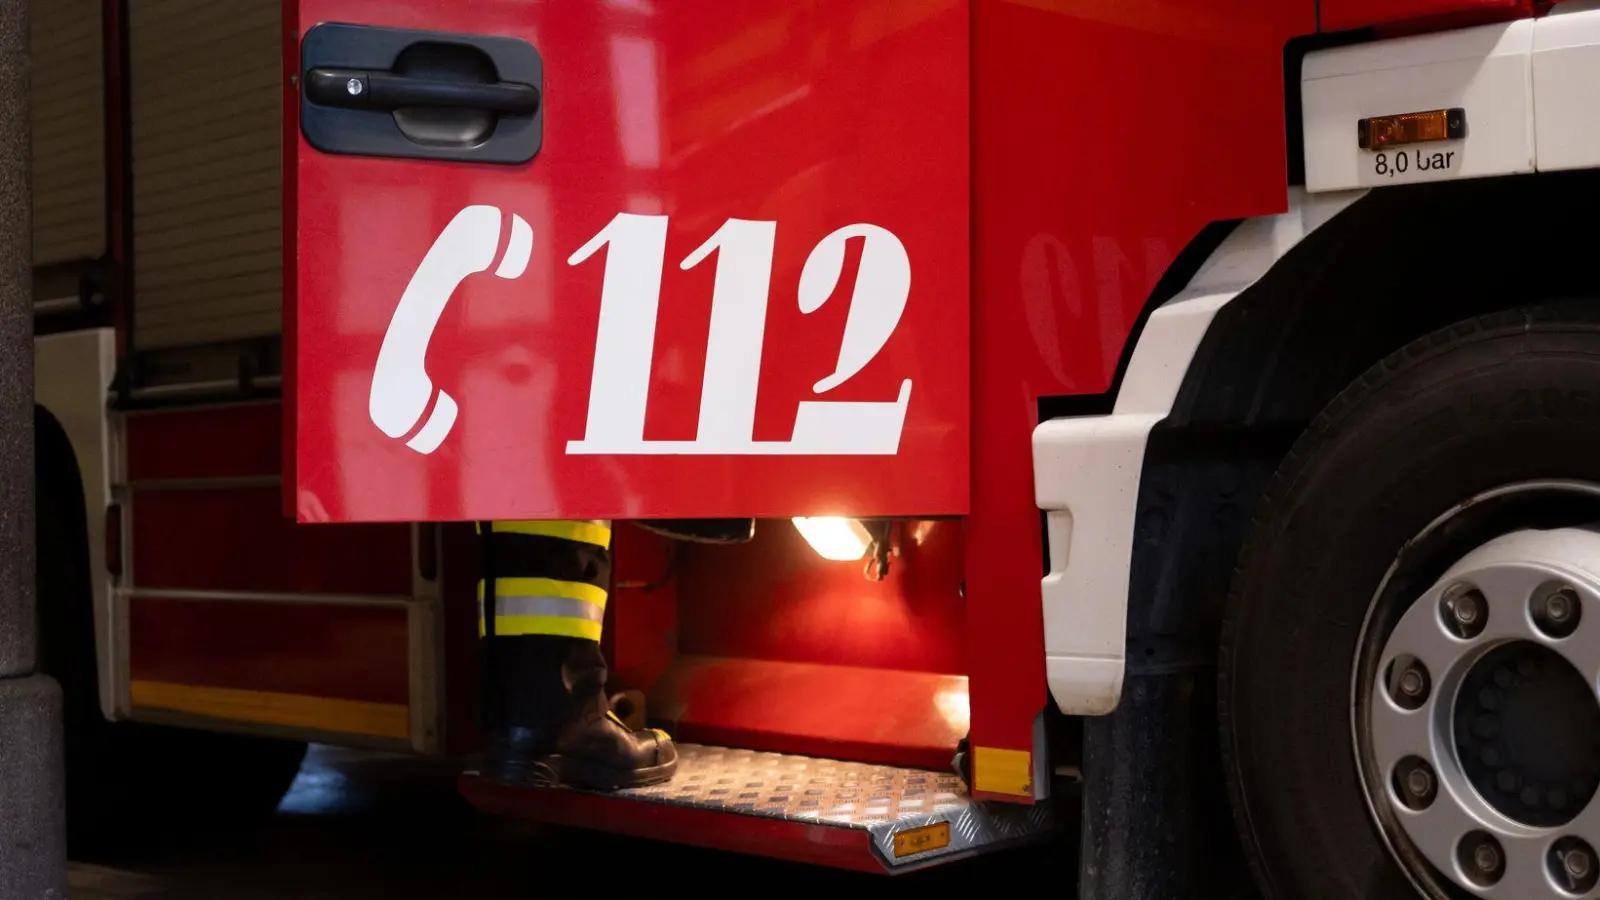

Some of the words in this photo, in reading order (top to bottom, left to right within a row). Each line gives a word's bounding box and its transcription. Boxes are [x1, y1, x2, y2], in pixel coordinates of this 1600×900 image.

[1375, 151, 1409, 177] 8,0
[1416, 149, 1455, 171] bar
[565, 212, 912, 454] 112
